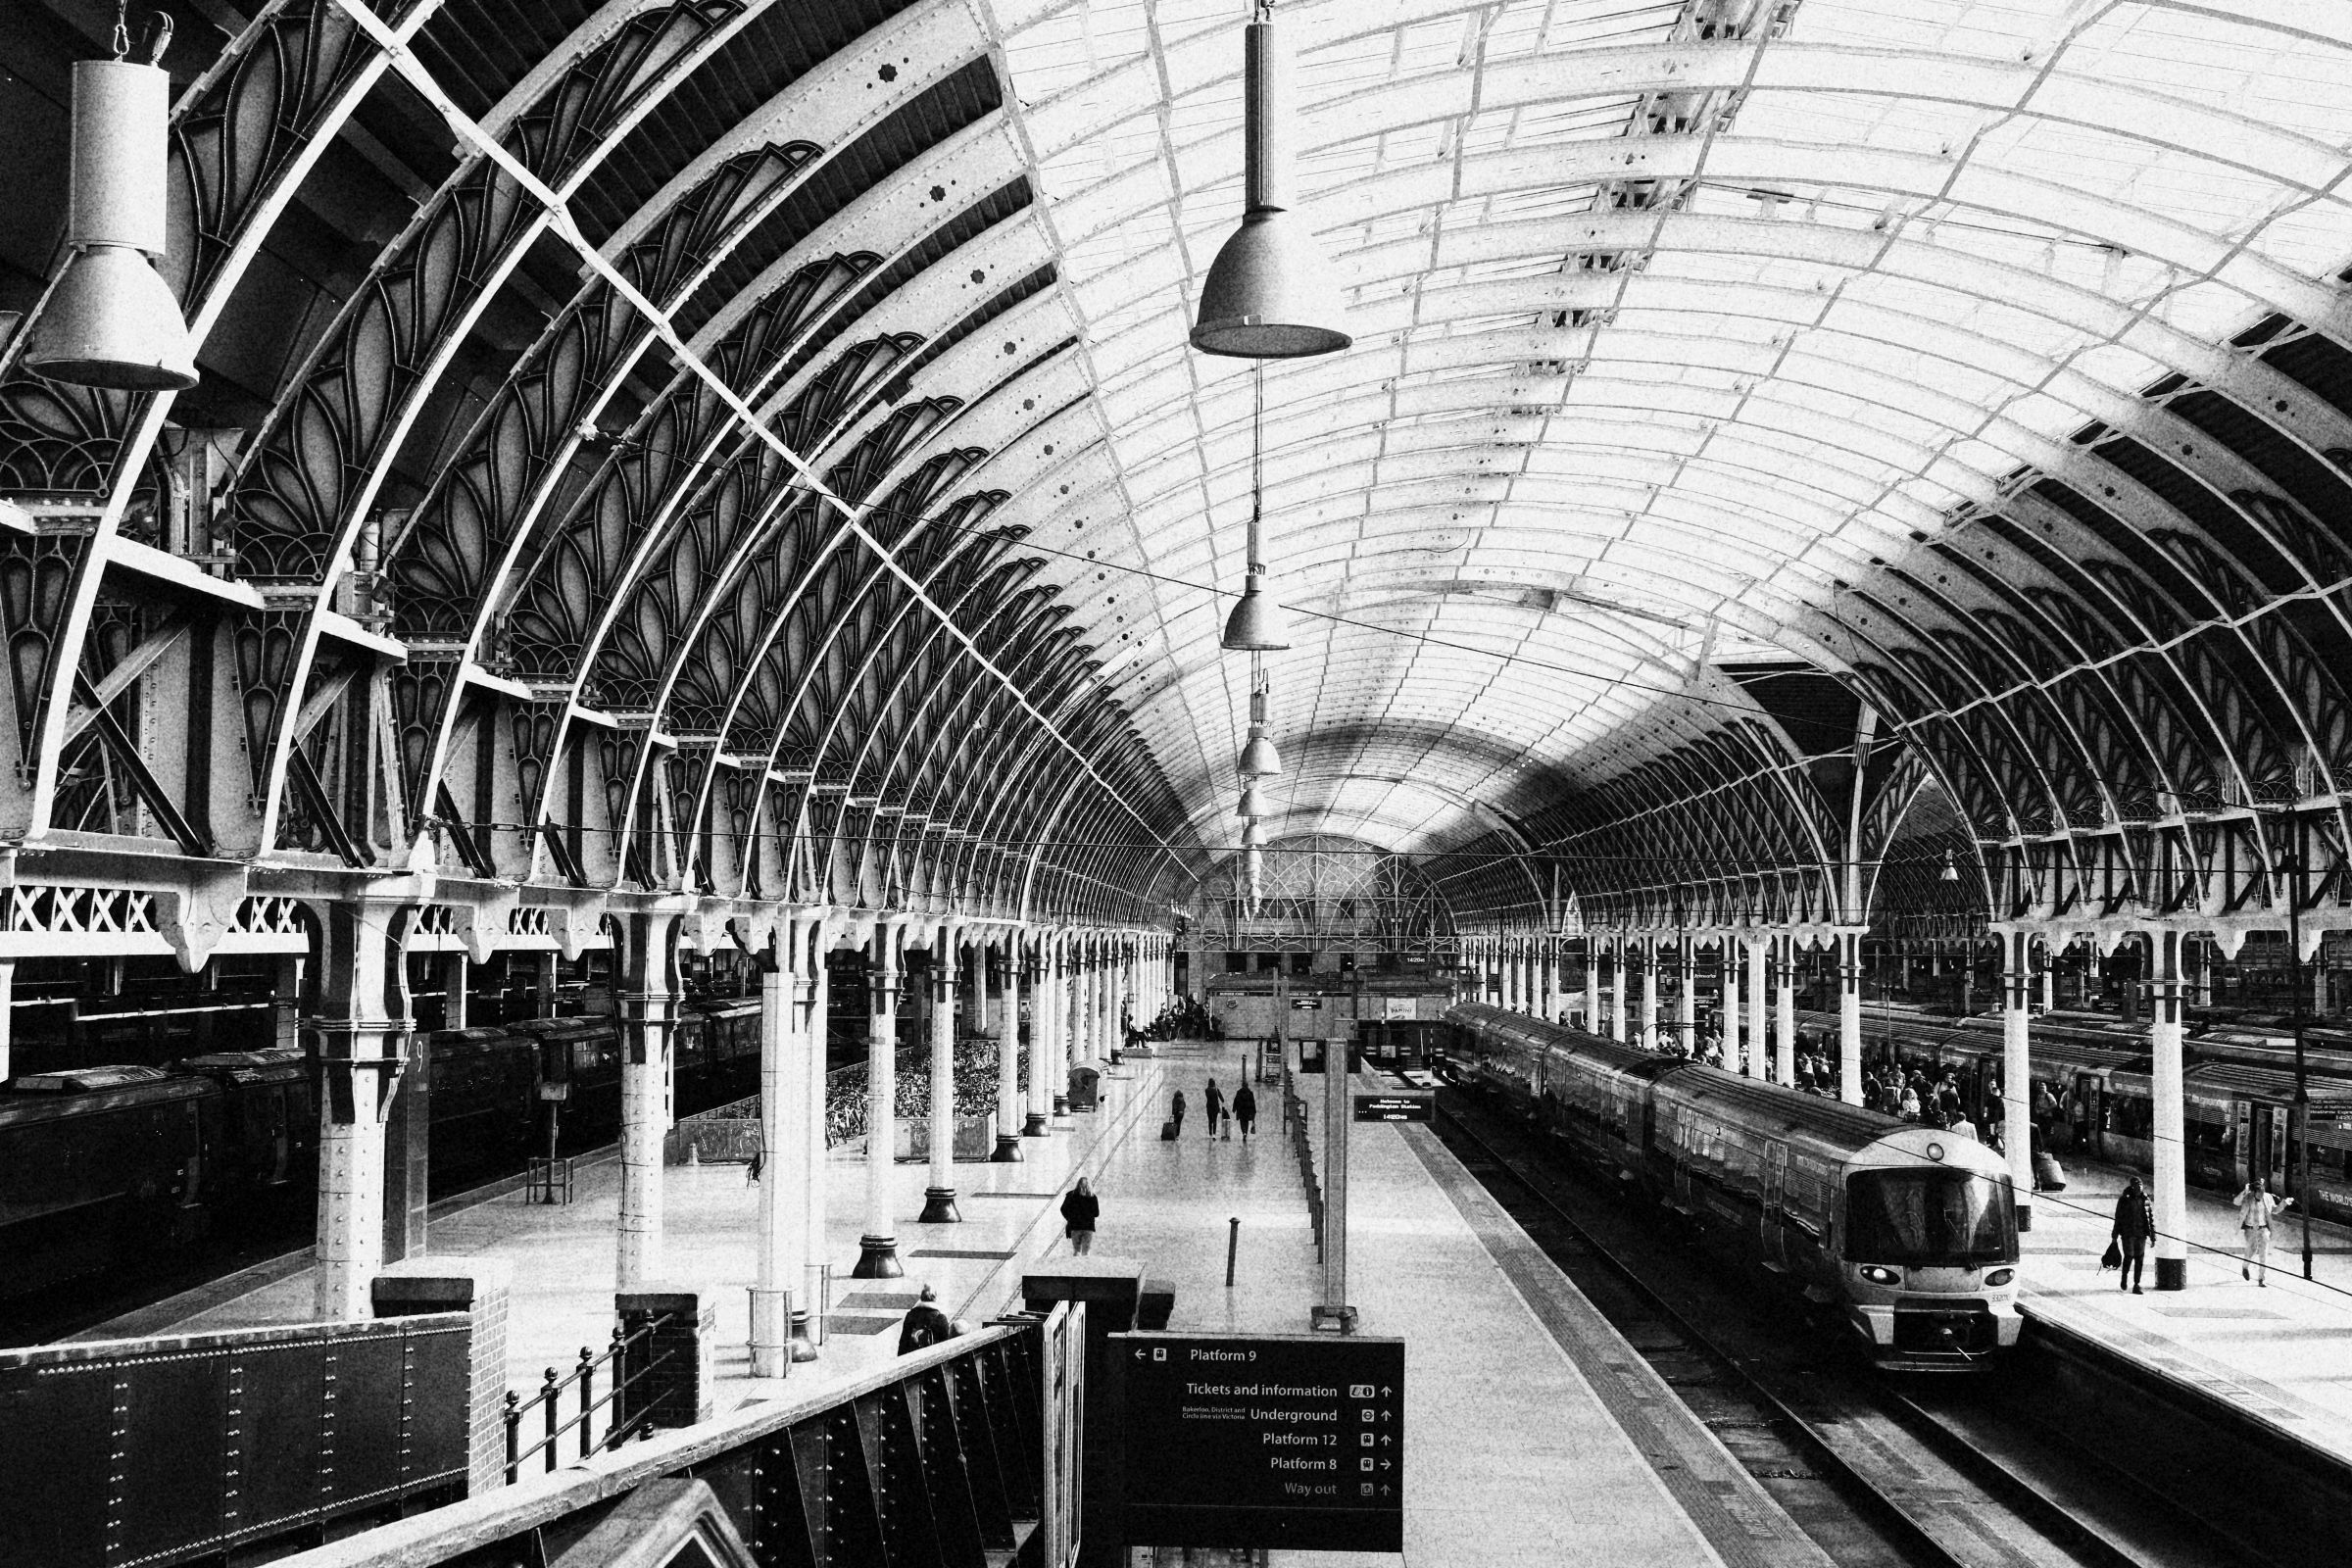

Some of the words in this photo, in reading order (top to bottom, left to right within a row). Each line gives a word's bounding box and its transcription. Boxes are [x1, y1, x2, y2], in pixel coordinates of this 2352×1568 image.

[416, 1040, 423, 1073] 9
[1190, 1348, 1246, 1361] Platform
[1249, 1350, 1257, 1361] 9
[1186, 1383, 1231, 1396] Tickets
[1233, 1384, 1258, 1396] and
[1261, 1384, 1338, 1397] information
[1250, 1408, 1338, 1424] Underground
[1263, 1433, 1318, 1446] Platform
[1322, 1434, 1338, 1446] 12
[1270, 1457, 1326, 1470] Platform
[1329, 1458, 1338, 1470] 8
[1285, 1482, 1312, 1496] Way
[1314, 1484, 1337, 1494] out
